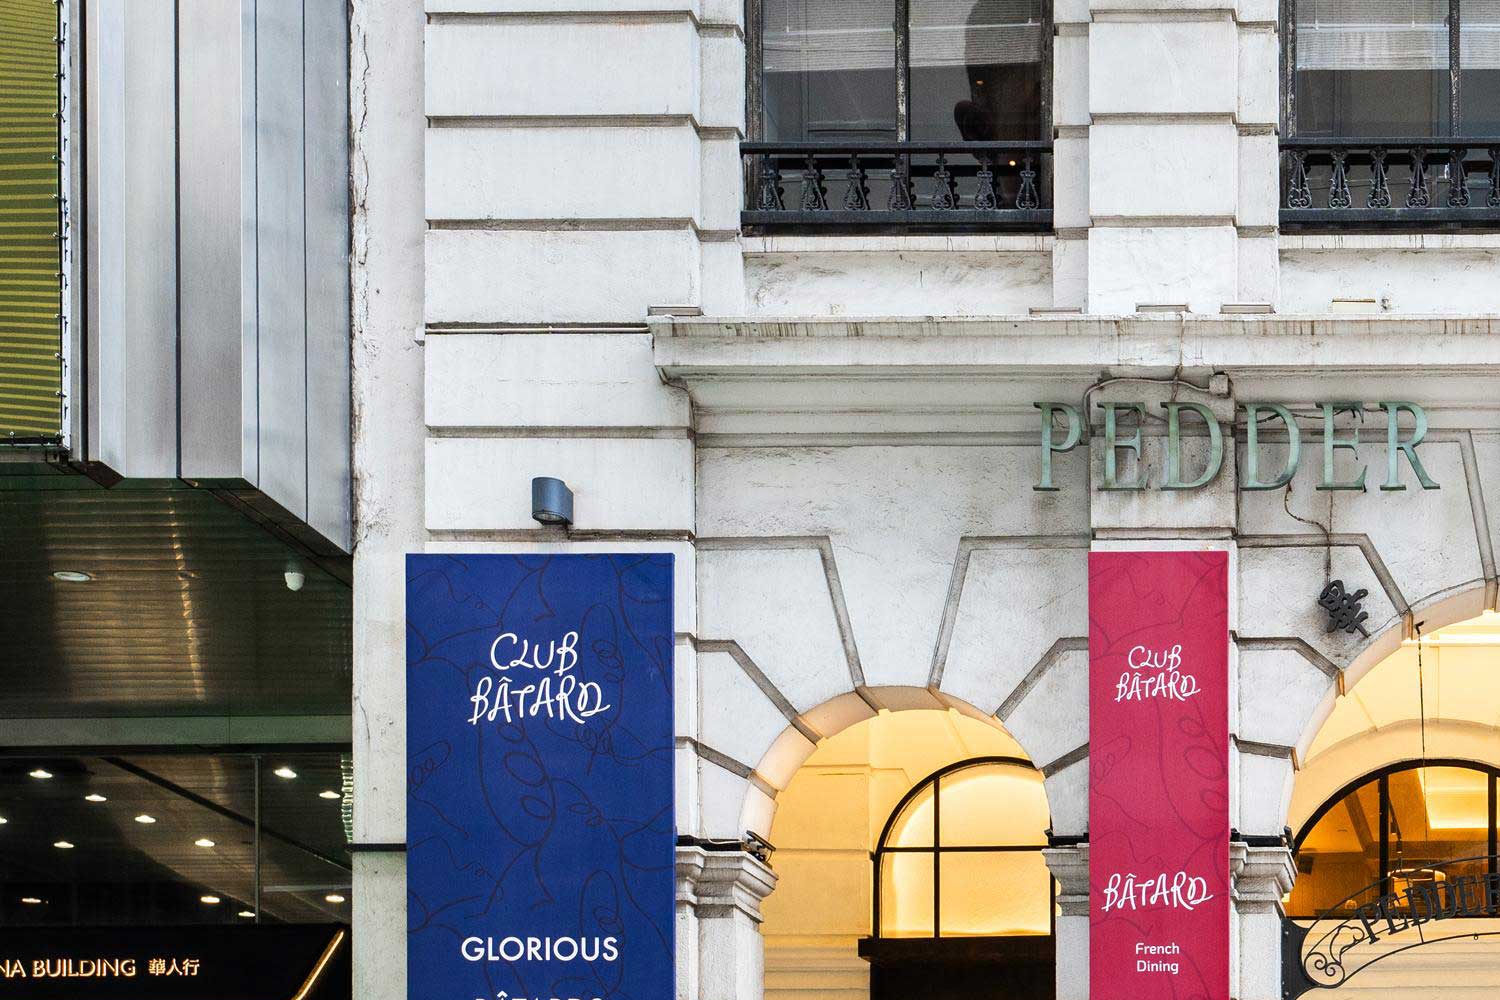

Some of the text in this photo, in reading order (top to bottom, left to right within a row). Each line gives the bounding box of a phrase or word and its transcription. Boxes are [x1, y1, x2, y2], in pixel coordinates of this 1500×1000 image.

[1032, 401, 1440, 491] PEDDER
[490, 631, 579, 677] CLUB
[1127, 644, 1182, 672] CLUB
[467, 674, 611, 726] BÂTARD
[1114, 670, 1201, 703] BÂTARD
[1101, 871, 1214, 912] BÂTARD
[461, 936, 619, 962] GLORIOUS
[1135, 942, 1180, 955] French
[32, 958, 137, 978] BUILDING
[148, 958, 200, 976] 華人行
[1136, 960, 1179, 975] Dining
